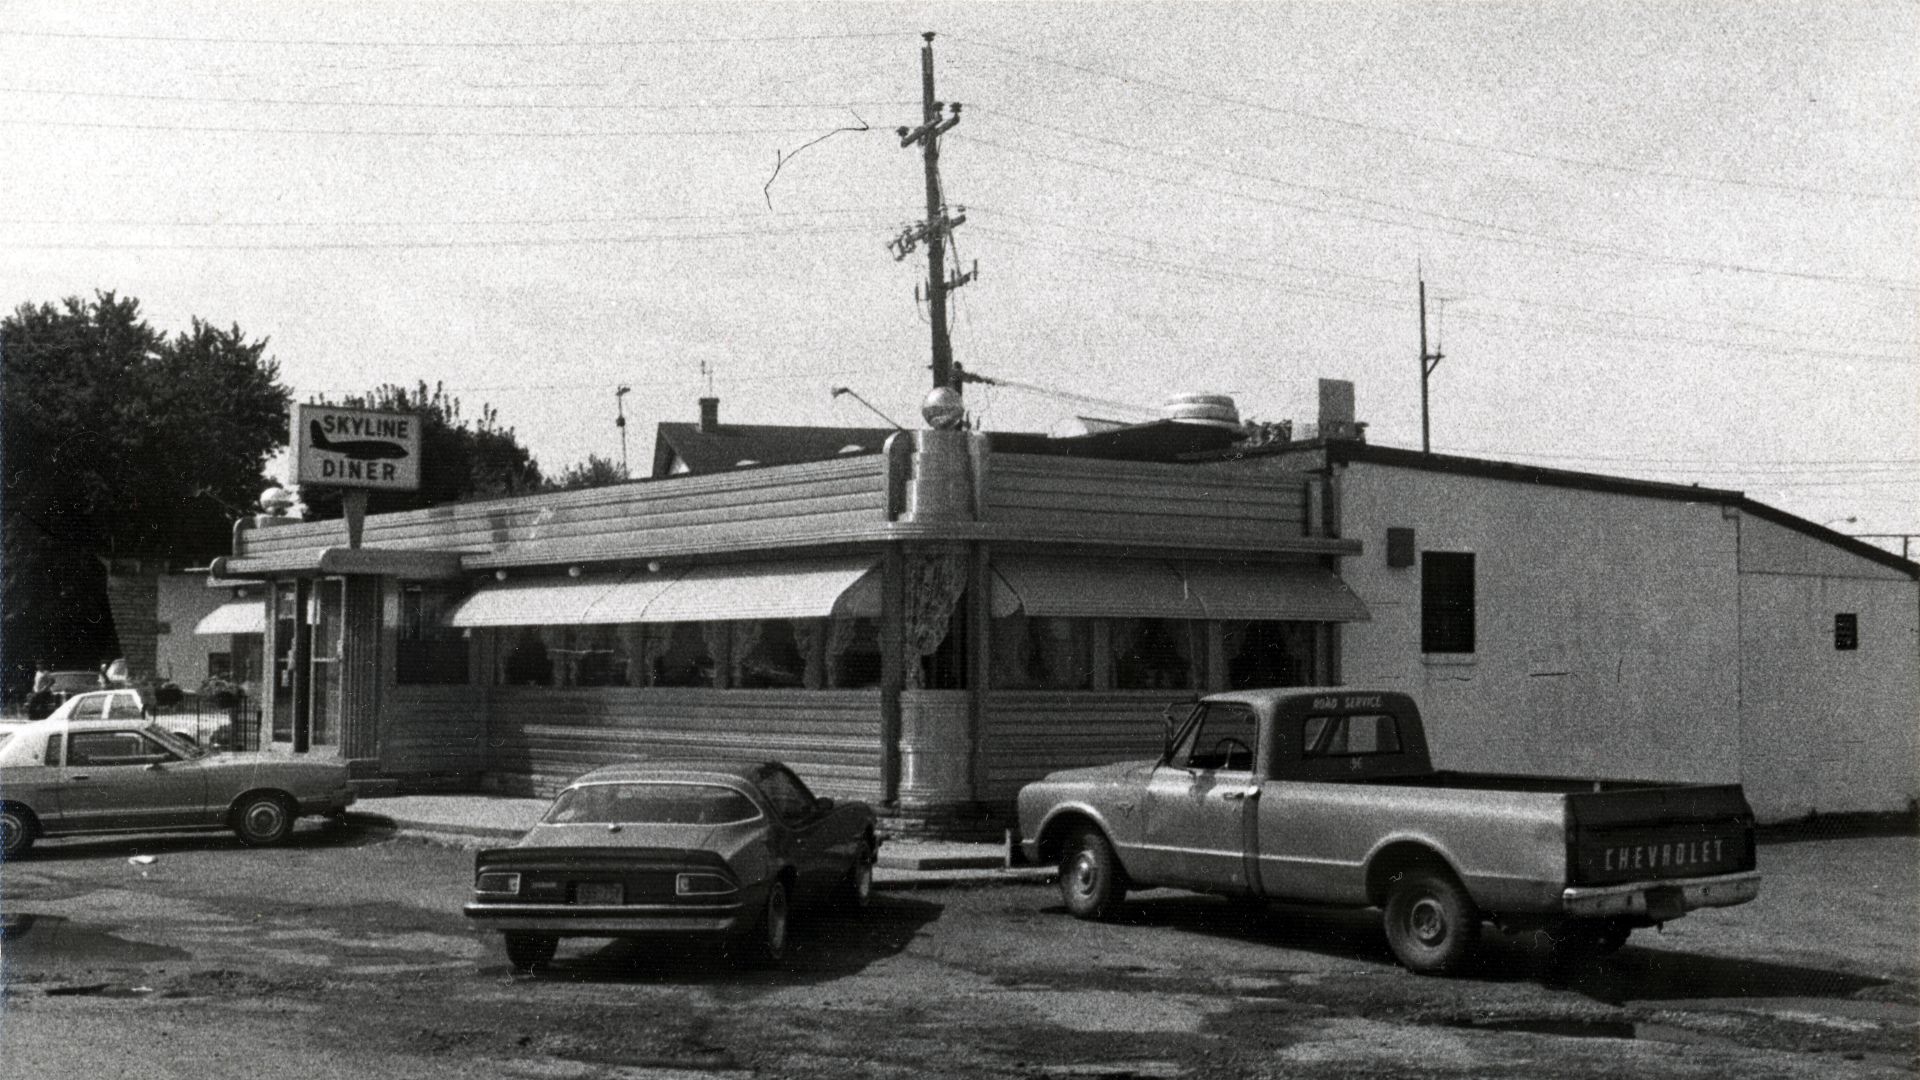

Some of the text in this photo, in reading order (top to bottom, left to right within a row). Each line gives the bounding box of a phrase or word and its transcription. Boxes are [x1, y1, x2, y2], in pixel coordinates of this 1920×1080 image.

[323, 415, 409, 439] SKYLINE
[322, 459, 395, 480] DINER
[1312, 696, 1382, 709] ROAD SERVICE
[1604, 840, 1723, 871] CHEVROLET
